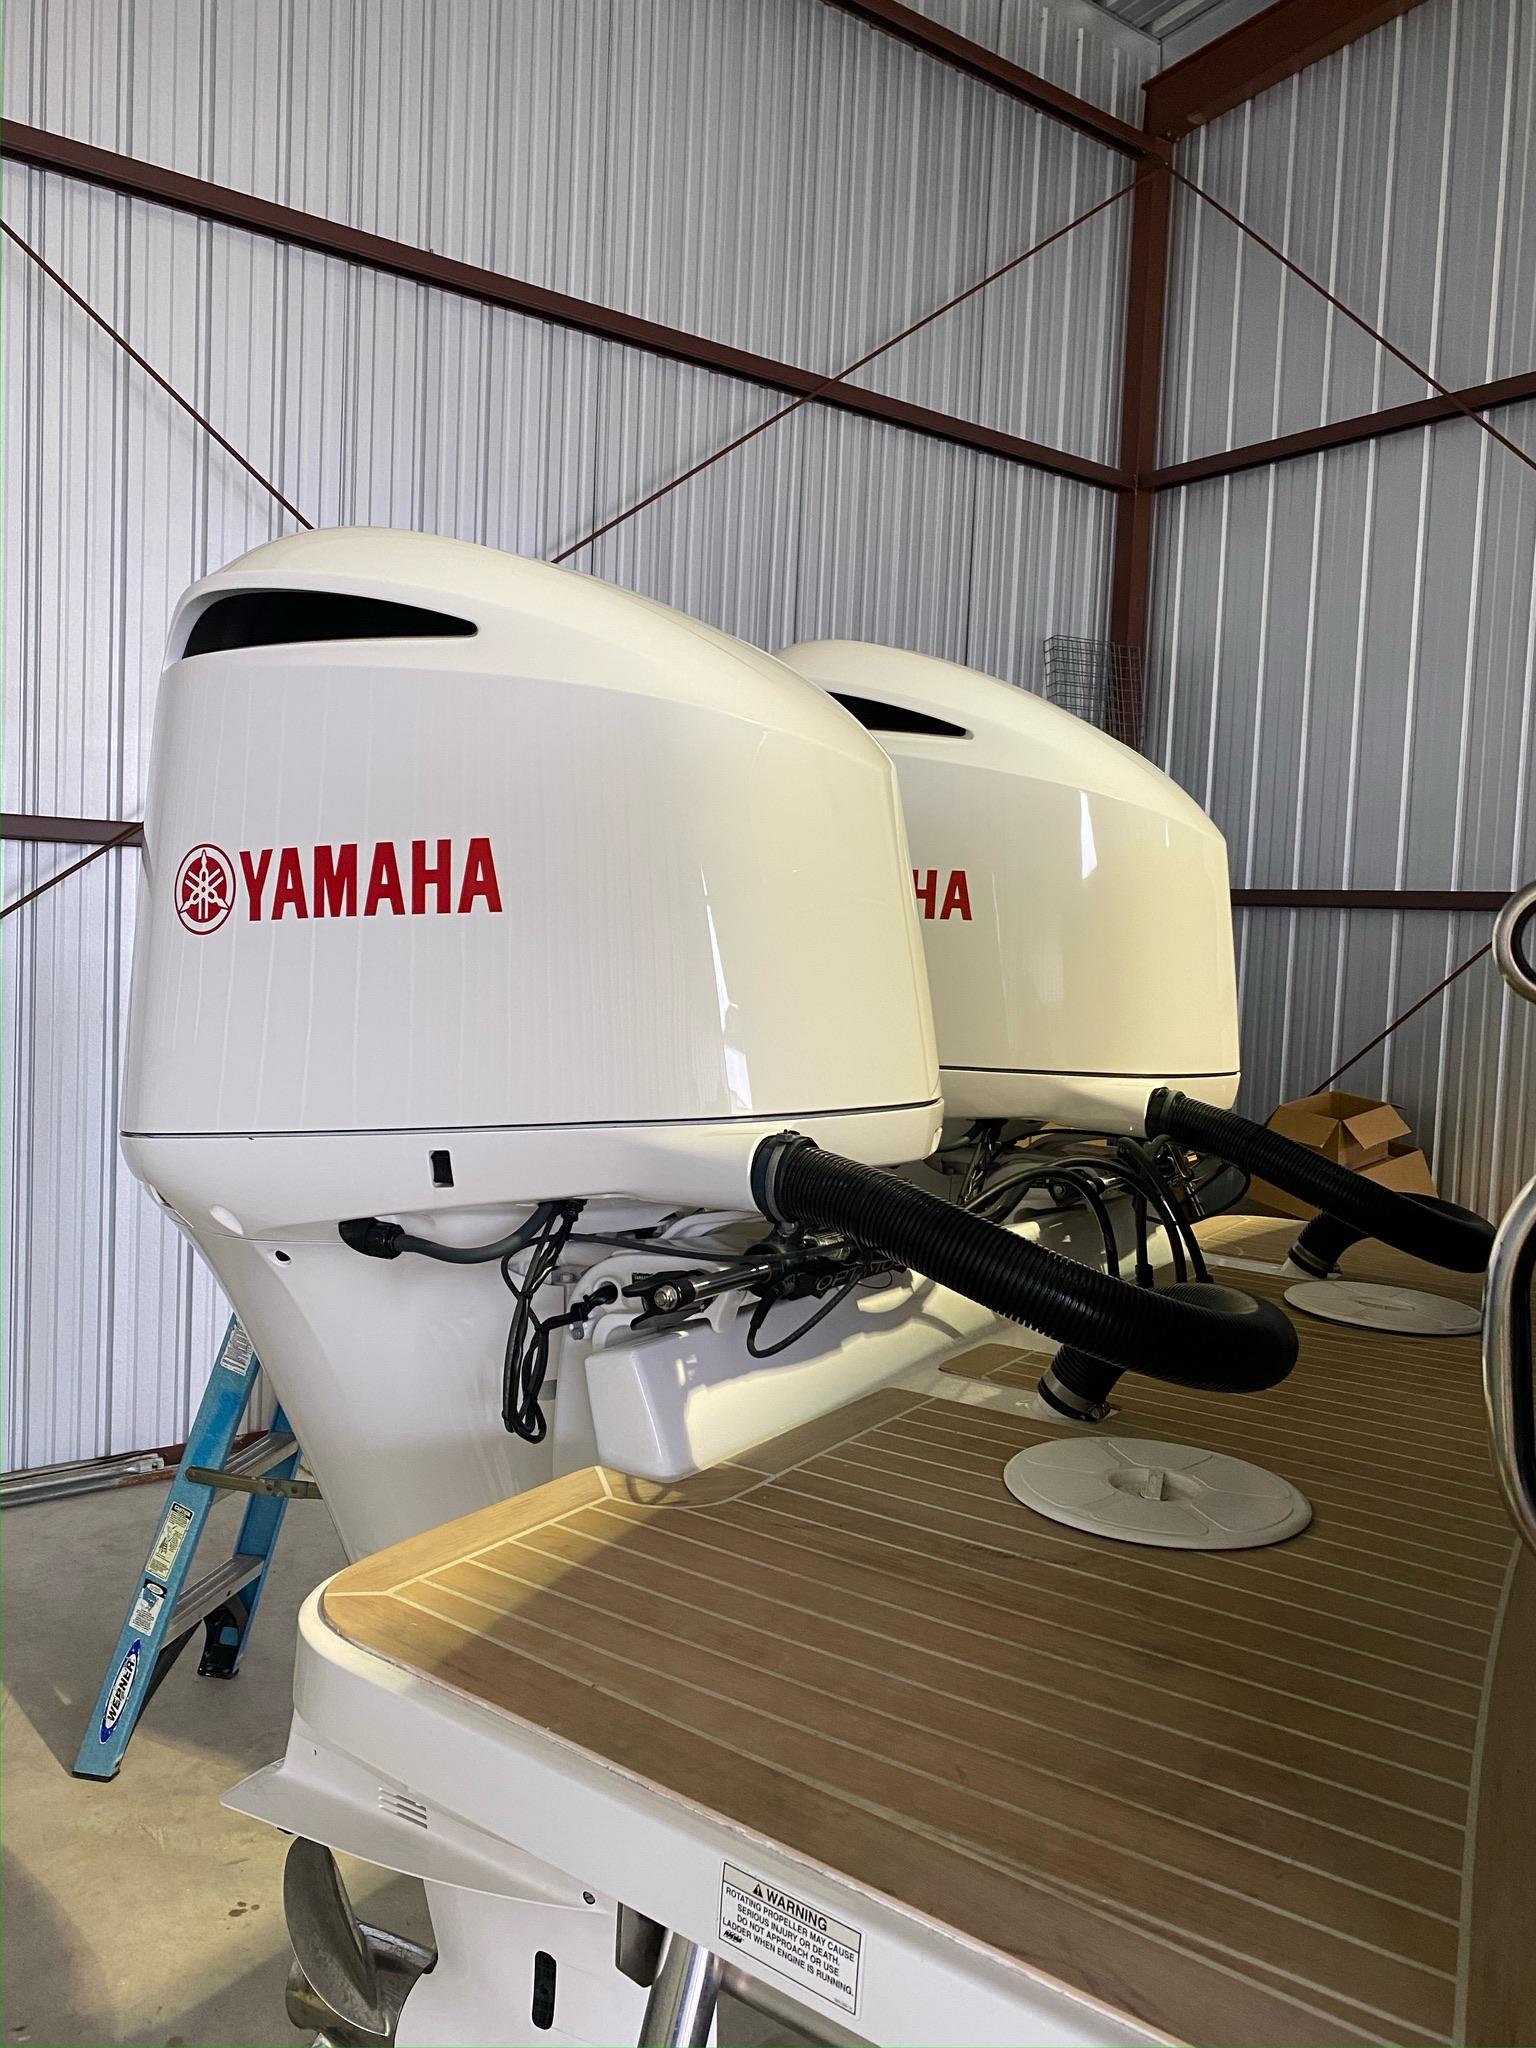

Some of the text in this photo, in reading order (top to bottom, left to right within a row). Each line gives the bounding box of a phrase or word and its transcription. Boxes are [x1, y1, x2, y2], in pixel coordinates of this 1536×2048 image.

[239, 837, 502, 921] YAMAHA
[107, 1659, 135, 1721] WERNER
[726, 1887, 855, 1962] ROTATING PROPELLER MAY CAUSE
[737, 1903, 840, 1966] SERIOUS INJURY OR DEATH.
[767, 1888, 828, 1932] WARNING
[723, 1916, 752, 1940] LADDER
[754, 1935, 776, 1953] WHEN
[777, 1949, 805, 1970] ENGINE
[807, 1964, 814, 1974] IS
[816, 1969, 854, 1996] RUNNING.
[737, 1914, 839, 1977] DO NOT APPROACH OR USE
